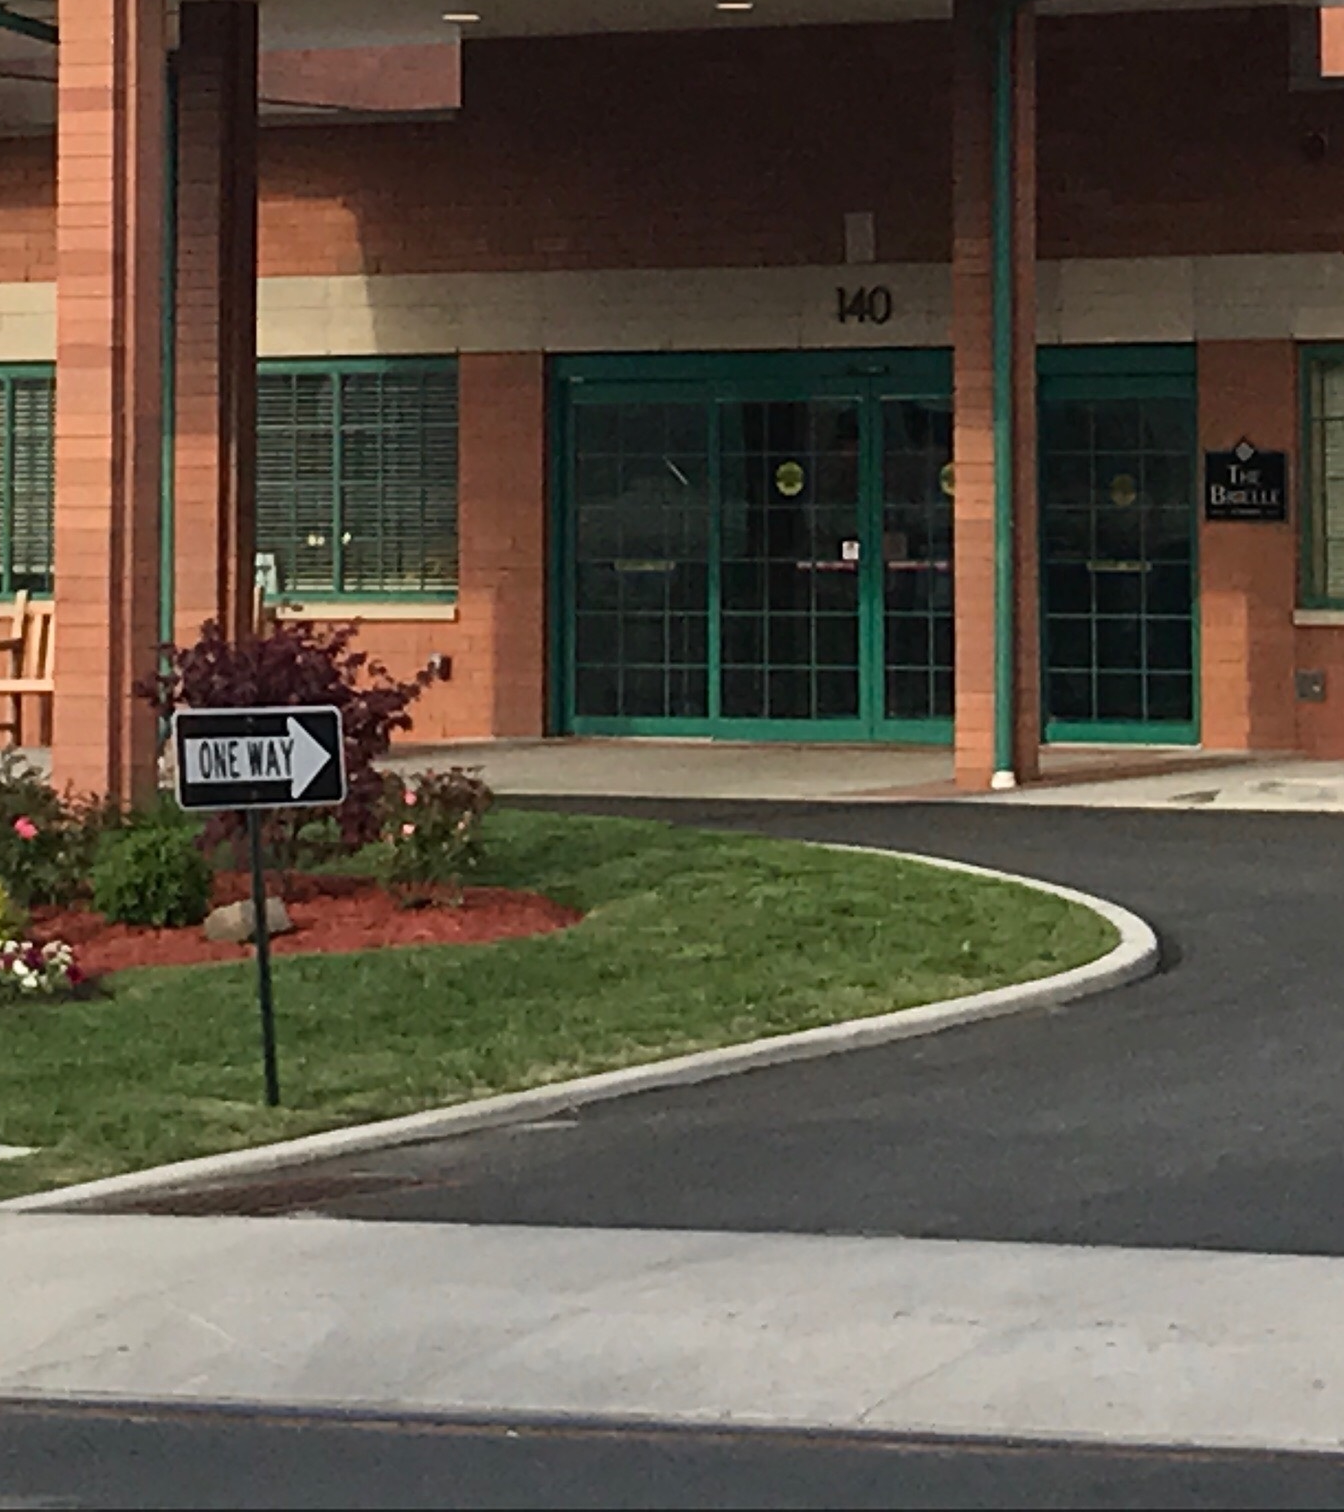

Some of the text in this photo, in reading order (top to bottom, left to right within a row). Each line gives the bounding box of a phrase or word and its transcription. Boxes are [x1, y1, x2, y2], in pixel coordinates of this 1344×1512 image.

[837, 286, 892, 325] 140
[199, 739, 294, 779] ONE WAY
